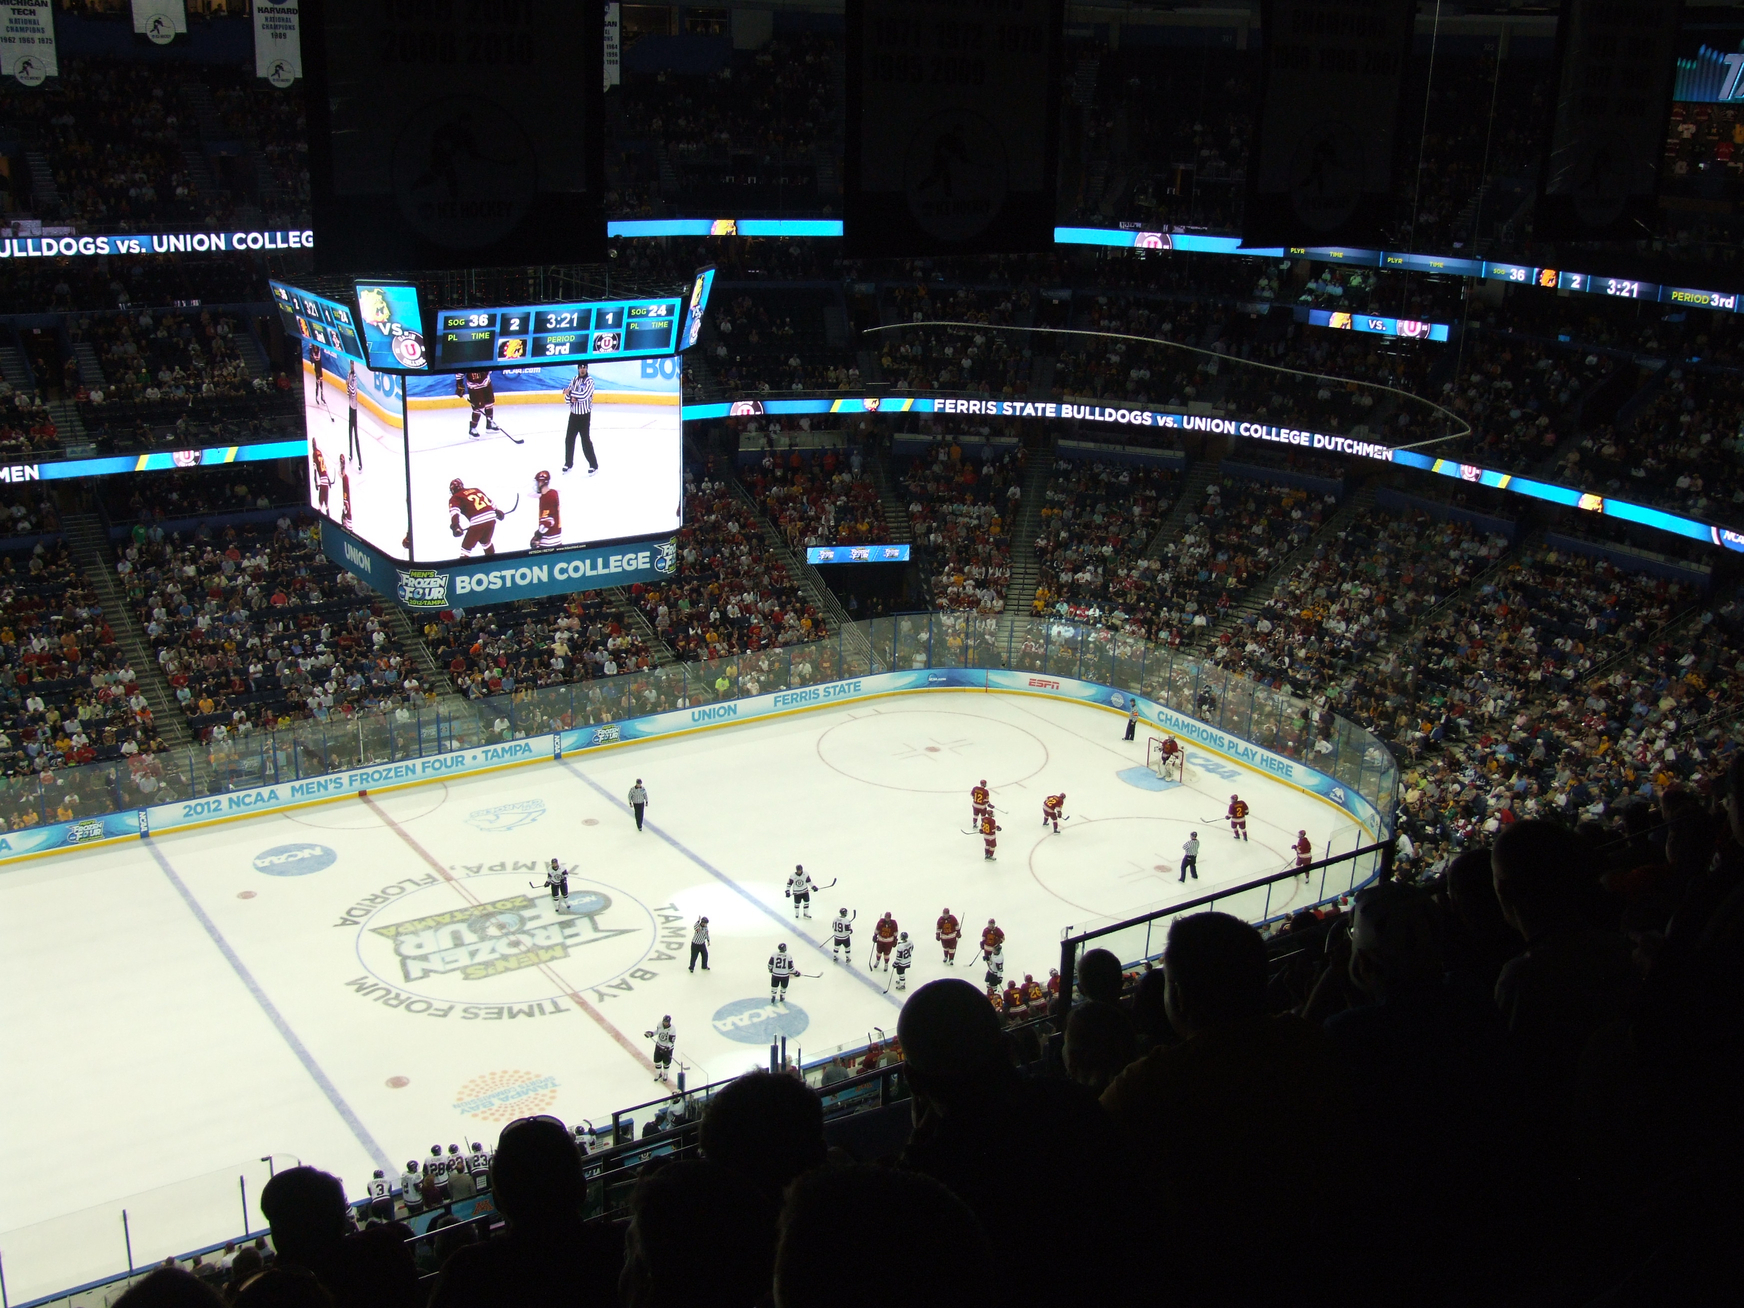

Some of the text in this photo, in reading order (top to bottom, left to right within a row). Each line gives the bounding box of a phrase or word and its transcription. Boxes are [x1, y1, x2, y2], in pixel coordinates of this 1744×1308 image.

[10, 8, 36, 16] TECH
[257, 6, 299, 15] HARVARD
[8, 18, 40, 26] NATIONAL
[261, 23, 296, 31] CHAMPIONS
[6, 26, 46, 34] CHAMPIONS
[152, 233, 226, 253] UNION
[1510, 268, 1525, 281] 36
[1571, 275, 1581, 288] 2
[1606, 279, 1639, 298] 3:21
[1671, 291, 1710, 305] PERIOD
[1710, 293, 1734, 308] 3rd
[448, 304, 667, 331] SOG 36 2 3:21 1 SOG 24
[379, 322, 409, 336] VS.
[448, 320, 668, 343] PL TIME PERIOD PL TIME
[1368, 319, 1386, 331] VS.
[545, 343, 569, 355] 3rd
[934, 398, 997, 415] FERRIS
[1002, 400, 1056, 417] STATE
[1061, 403, 1152, 426] BULLDOGS
[1182, 415, 1236, 435] UNION
[1239, 422, 1310, 446] COLLEGE
[1313, 433, 1394, 461] DUTCHMEN
[343, 541, 371, 574] UNION
[455, 564, 548, 595] BOSTON
[553, 551, 651, 581] COLLEGE
[402, 574, 446, 588] FROZEN
[404, 587, 444, 601] FOUR
[1028, 678, 1060, 690] ESPN
[691, 681, 862, 723] UNION FERRIS STATE
[1157, 710, 1294, 778] CHAMPIONS PLAY HERE
[1186, 751, 1242, 780] CAA
[182, 742, 533, 818] 2012 NCAA MEN'S FROZEN FOUR TAMPA
[974, 792, 983, 803] 12
[1236, 807, 1243, 817] 2
[139, 812, 148, 832] NCAA
[253, 845, 324, 868] NCAA
[333, 873, 440, 928] FLORIDA
[833, 922, 844, 932] 19
[344, 902, 688, 1021] TAMPA BAY TIMES FORUM
[775, 957, 786, 969] 21
[1013, 993, 1020, 1005] 7
[1028, 986, 1042, 998] 26
[712, 1000, 790, 1033] NCAA
[459, 1081, 561, 1115] TAMPA BAY
[472, 1154, 488, 1167] 23
[429, 1162, 446, 1177] 28
[375, 1183, 384, 1196] 3
